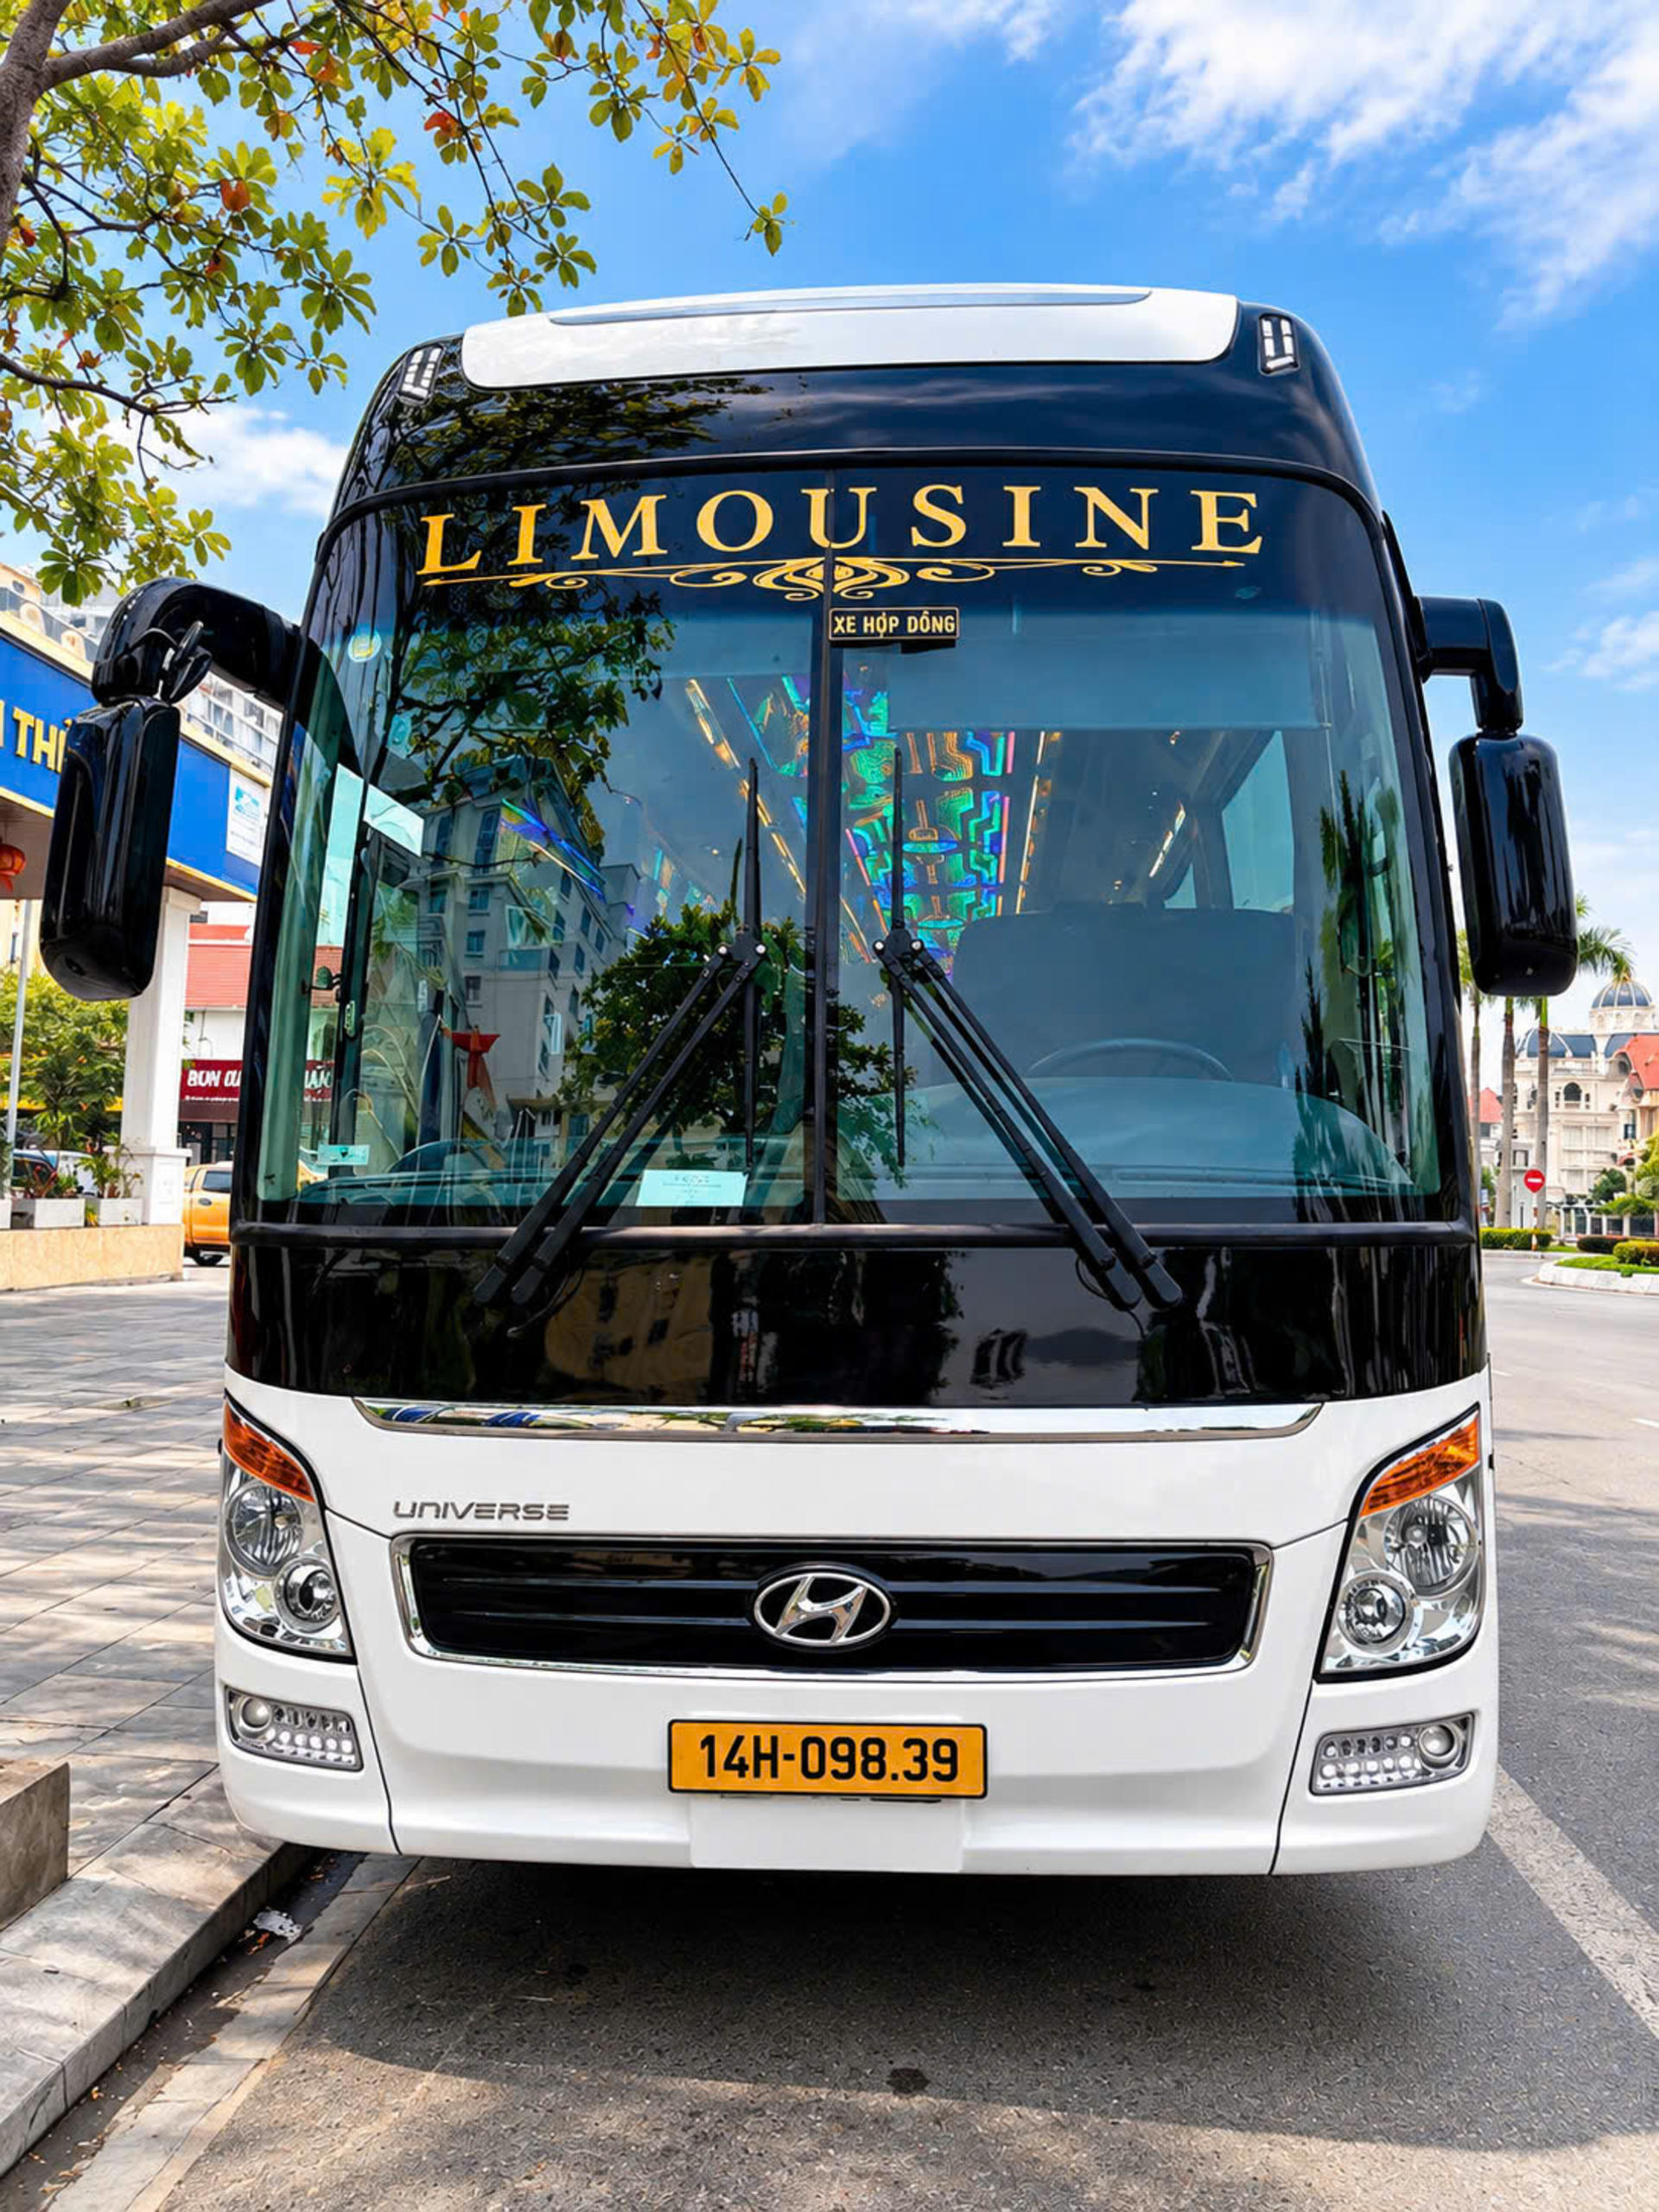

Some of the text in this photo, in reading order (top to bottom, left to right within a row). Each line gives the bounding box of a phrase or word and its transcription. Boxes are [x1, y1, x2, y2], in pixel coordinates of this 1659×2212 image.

[416, 484, 1263, 575] LIMOUSINE
[833, 615, 856, 634] XE
[392, 1501, 570, 1521] UNIVERSE
[699, 1734, 959, 1783] 14H-098.39
